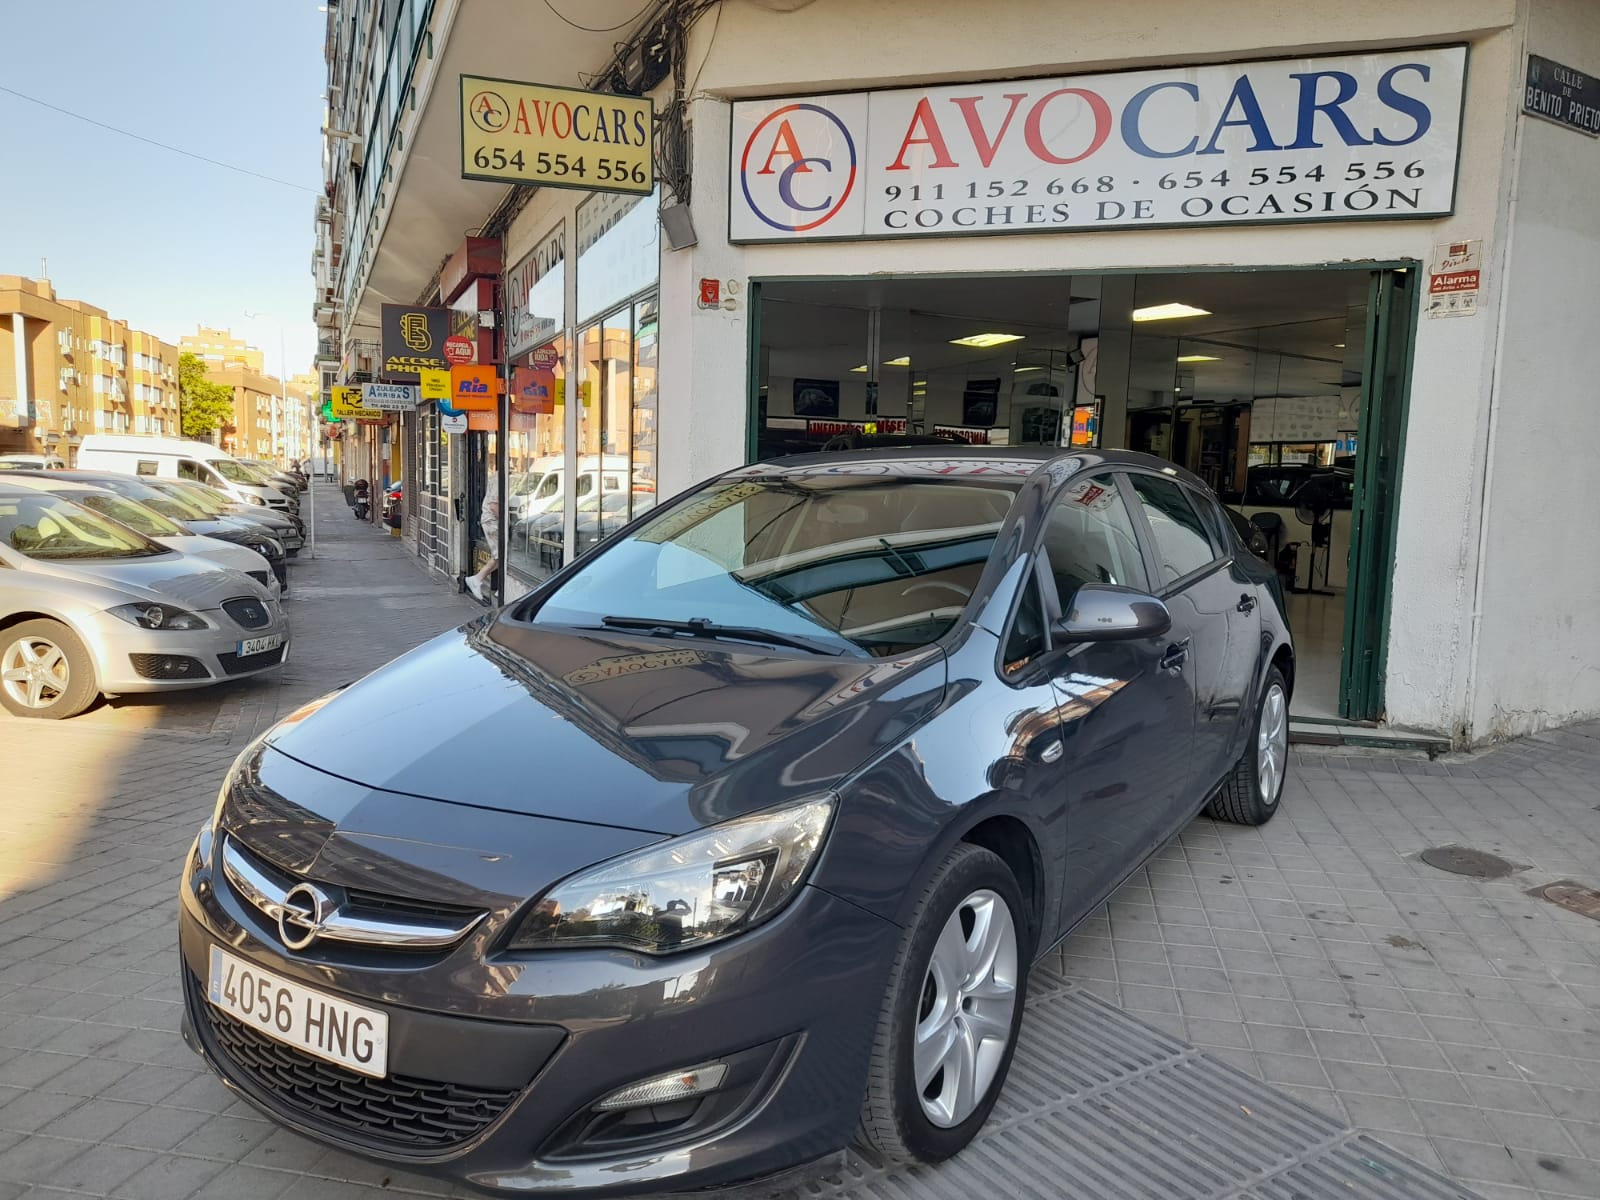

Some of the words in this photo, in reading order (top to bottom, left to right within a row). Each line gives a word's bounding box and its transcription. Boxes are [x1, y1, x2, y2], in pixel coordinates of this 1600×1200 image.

[1553, 67, 1584, 90] CALLE
[1562, 86, 1573, 97] DE
[513, 97, 646, 147] AVOCARS
[886, 63, 1431, 171] AVOCARS
[1526, 86, 1562, 117] BENITO
[1568, 101, 1600, 130] PRIETO
[474, 146, 525, 172] 654
[536, 151, 586, 178] 554
[597, 158, 646, 184] 556
[884, 183, 946, 203] 911
[966, 179, 1029, 199] 152
[1046, 175, 1114, 196] 668
[1158, 169, 1231, 190] 654
[1248, 164, 1326, 186] 554
[1344, 159, 1425, 181] 556
[884, 202, 1070, 229] COCHES
[1095, 199, 1155, 222] DE
[1180, 183, 1423, 218] OCASIÓN
[1434, 275, 1477, 286] Alarma
[459, 377, 488, 393] Ria
[223, 963, 293, 1033] 4056
[305, 997, 374, 1064] HNG
